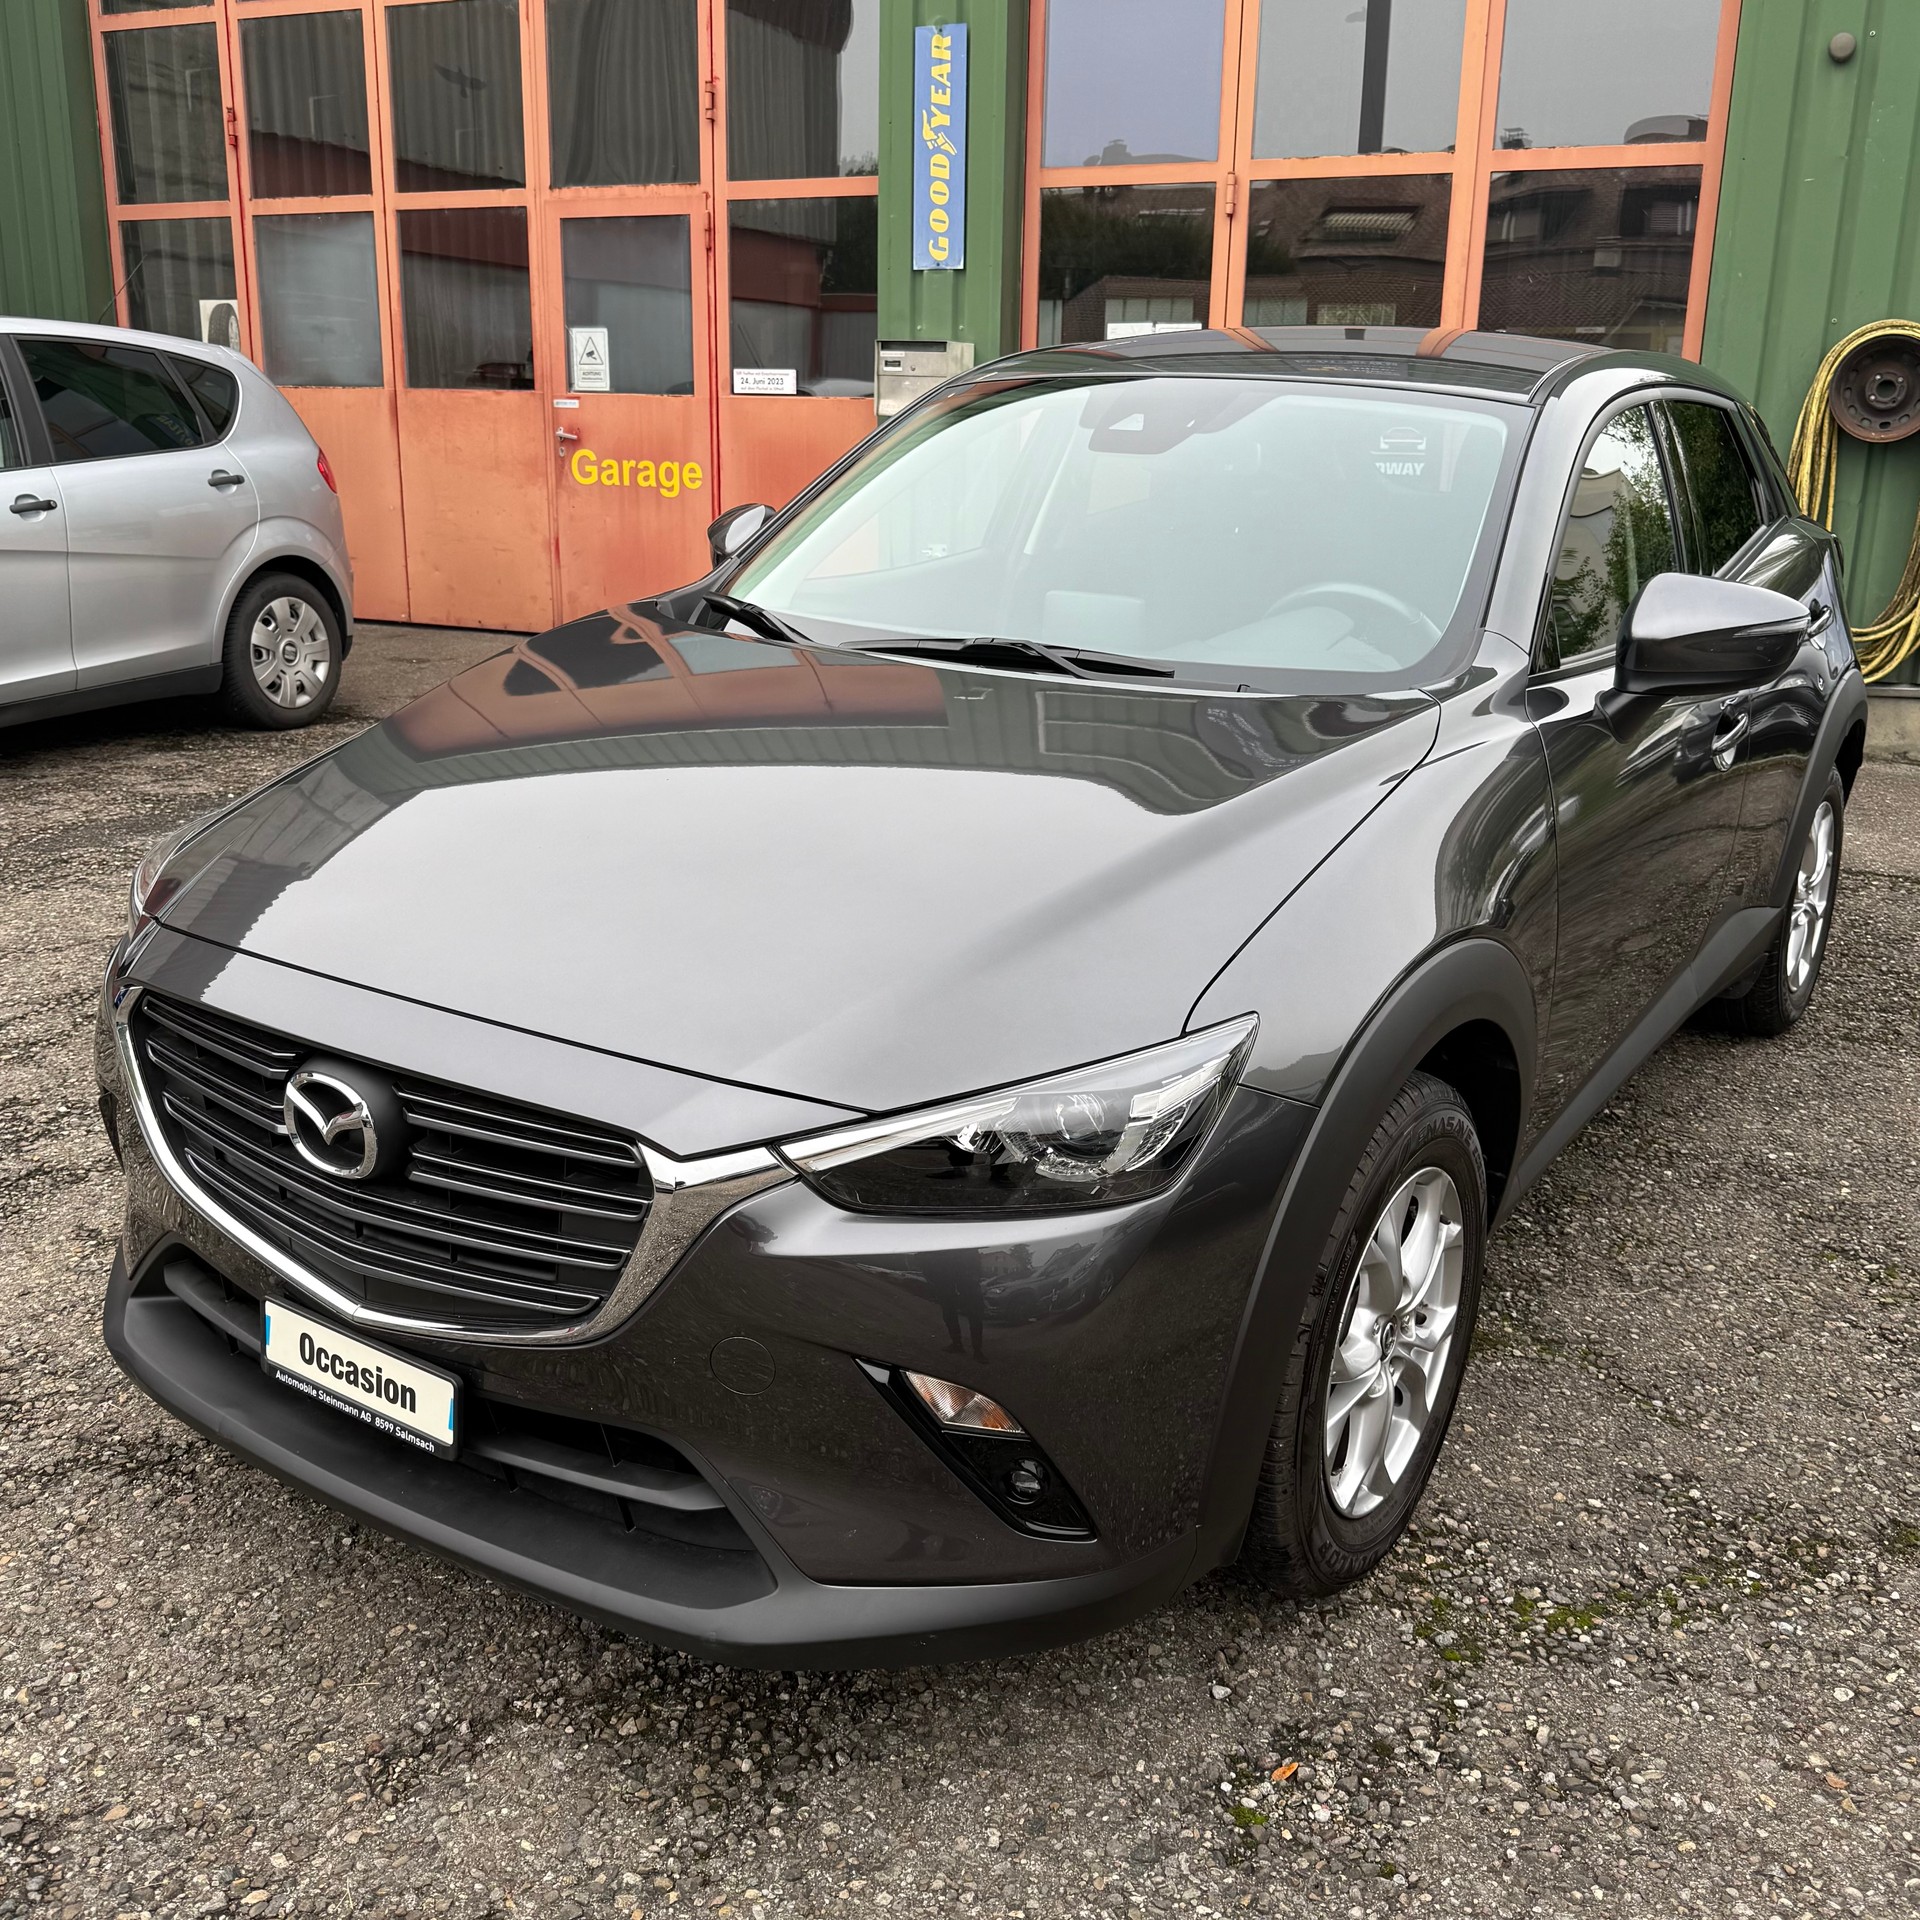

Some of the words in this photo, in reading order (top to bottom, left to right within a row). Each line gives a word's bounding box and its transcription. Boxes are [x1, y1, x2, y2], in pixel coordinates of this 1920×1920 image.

[927, 33, 953, 262] GOODYEAR
[740, 377, 751, 385] 24.
[752, 377, 766, 385] Juni
[767, 377, 784, 385] 2023
[571, 449, 703, 498] Garage
[275, 1370, 317, 1397] Automobile
[318, 1390, 359, 1418] Steinmann
[360, 1410, 372, 1423] AG
[374, 1417, 394, 1433] 8599
[395, 1427, 435, 1453] Salmsach
[299, 1332, 416, 1414] Occasion
